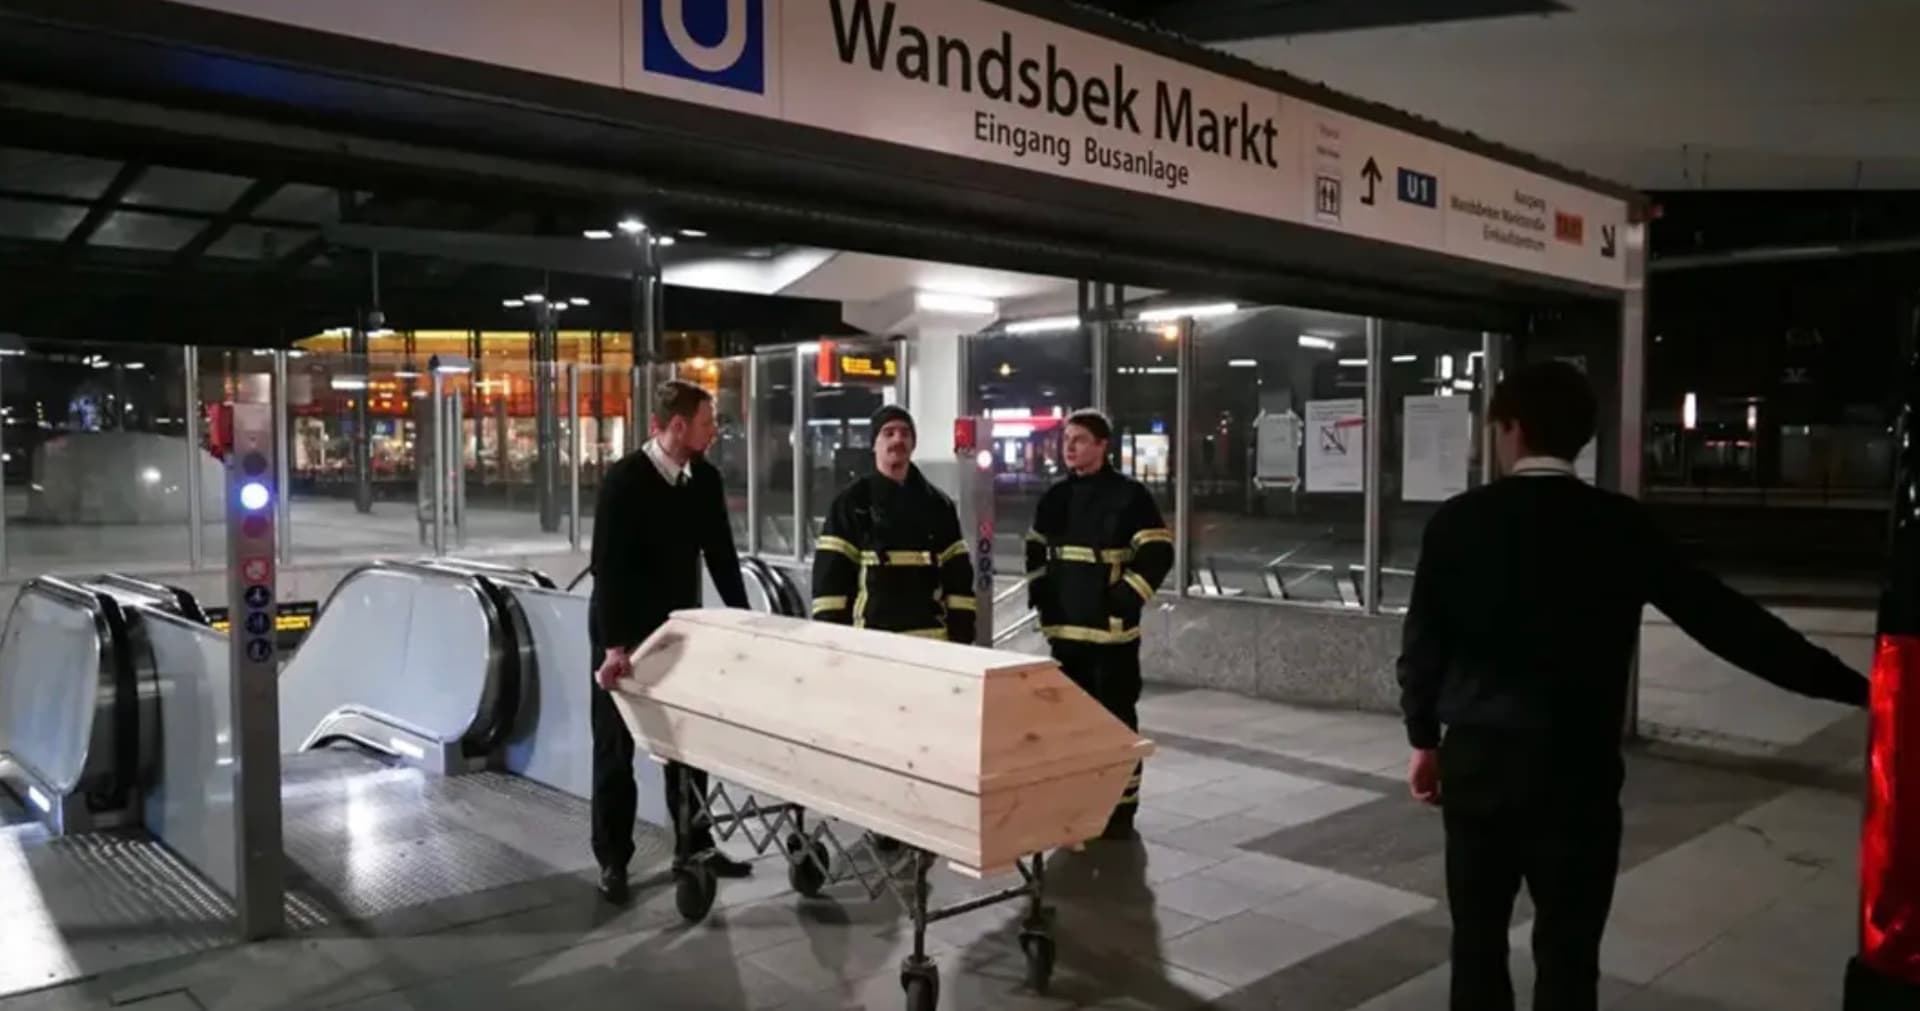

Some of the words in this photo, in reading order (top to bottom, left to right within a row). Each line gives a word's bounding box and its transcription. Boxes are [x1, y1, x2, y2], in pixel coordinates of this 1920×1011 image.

[661, 0, 747, 72] U
[831, 0, 1141, 135] Wandsbek
[1155, 80, 1278, 169] Markt
[974, 112, 1071, 165] Eingang
[1084, 136, 1190, 187] Busanlage
[1407, 174, 1427, 201] U1
